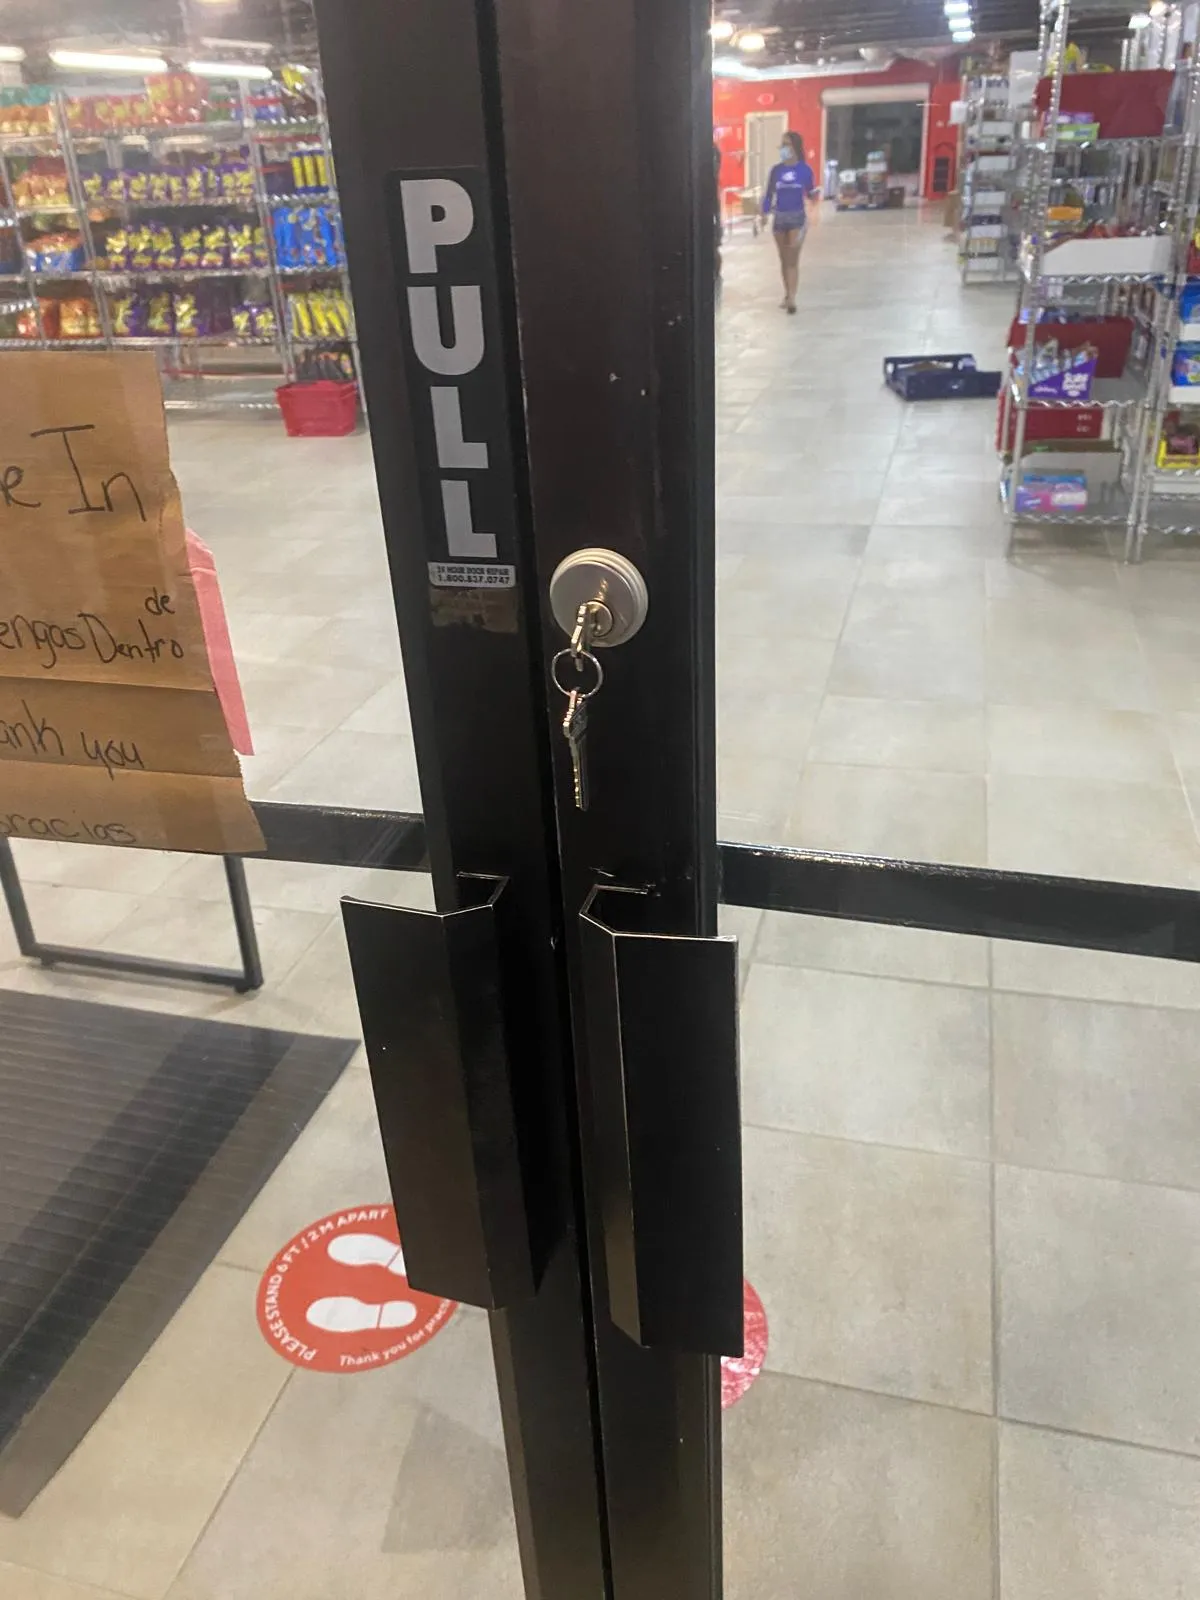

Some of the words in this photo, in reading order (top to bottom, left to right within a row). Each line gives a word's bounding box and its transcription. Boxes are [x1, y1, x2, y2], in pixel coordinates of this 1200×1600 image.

[400, 178, 497, 558] PULL
[30, 424, 147, 522] In
[145, 587, 175, 615] de
[77, 612, 184, 664] Dentro
[80, 731, 144, 781] you
[336, 1207, 389, 1228] APART
[276, 1263, 289, 1273] 6
[281, 1244, 301, 1263] FT
[265, 1273, 283, 1320] STAND
[269, 1318, 317, 1361] PLEASE
[339, 1352, 380, 1367] Thank
[382, 1341, 407, 1361] you
[405, 1328, 425, 1345] for
